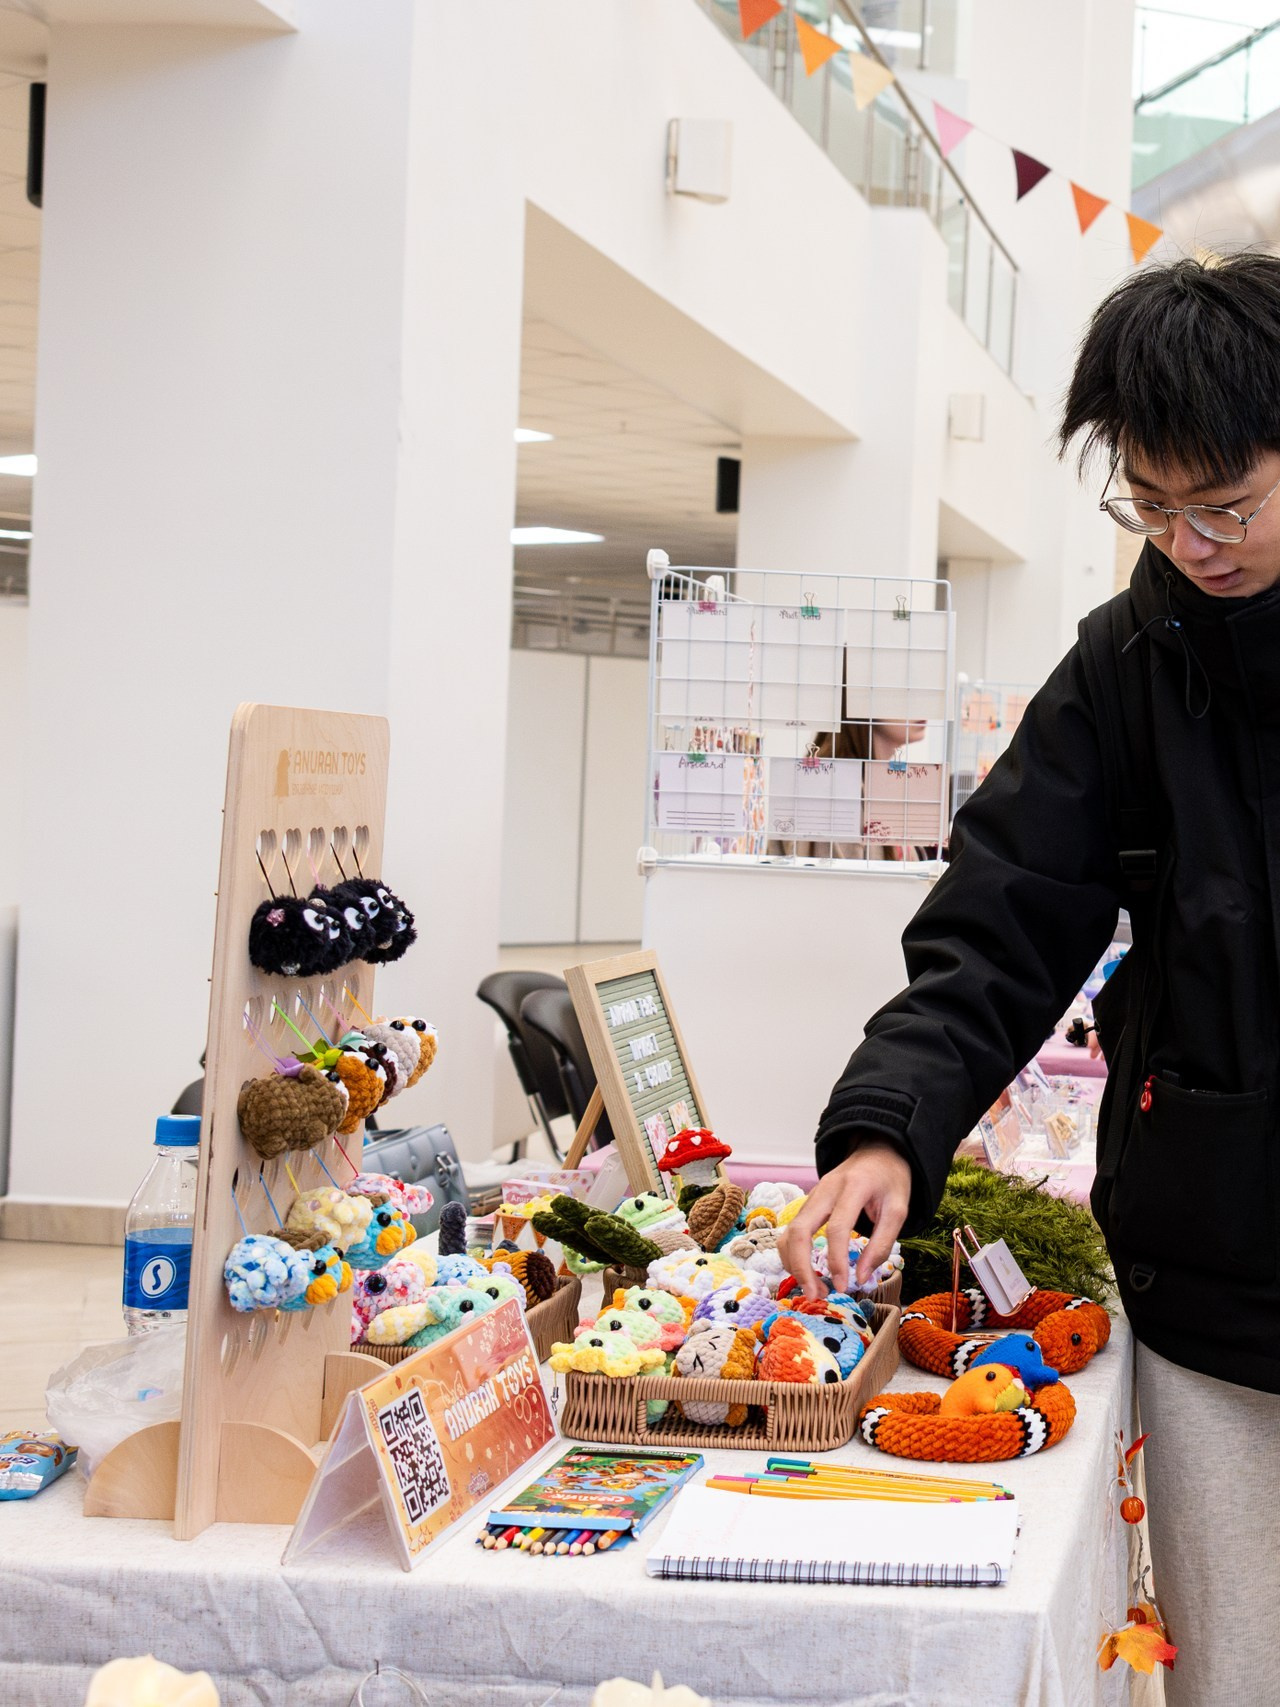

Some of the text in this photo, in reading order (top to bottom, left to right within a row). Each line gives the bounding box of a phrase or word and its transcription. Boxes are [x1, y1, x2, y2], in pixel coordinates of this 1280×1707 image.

[293, 750, 366, 775] ANURAN TOYS
[444, 1378, 501, 1441] ANURAN
[496, 1355, 533, 1402] TOYS
